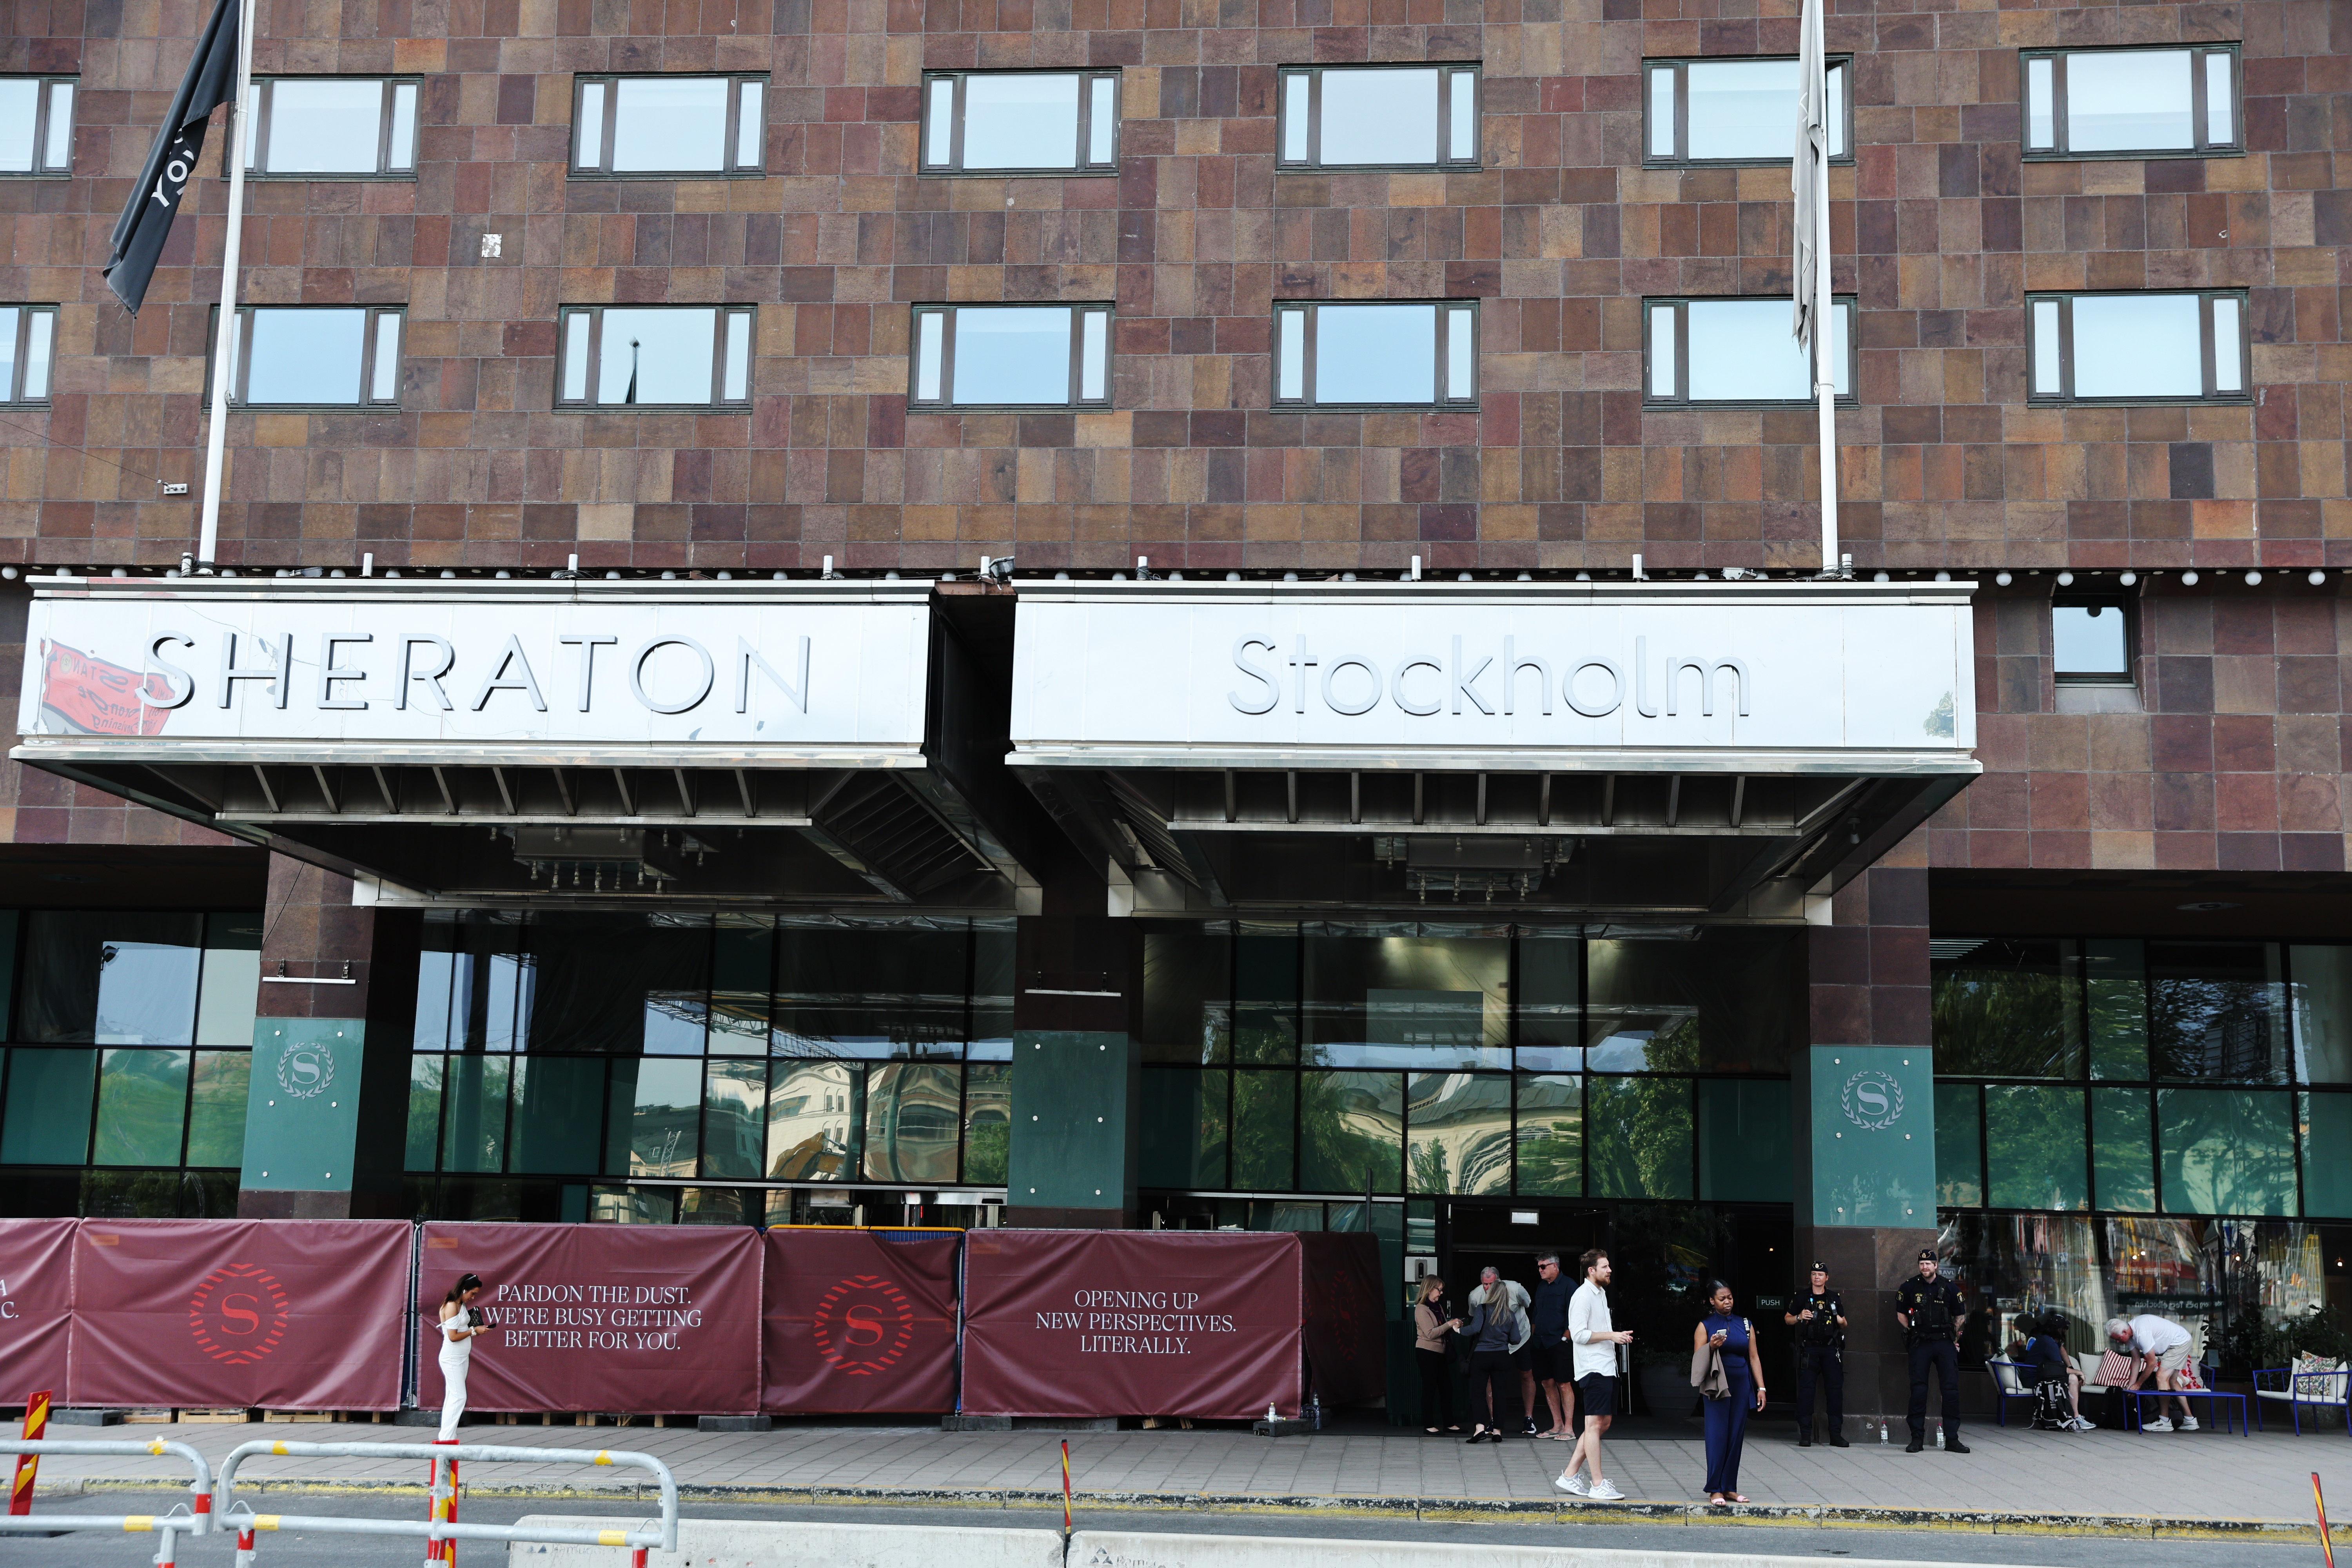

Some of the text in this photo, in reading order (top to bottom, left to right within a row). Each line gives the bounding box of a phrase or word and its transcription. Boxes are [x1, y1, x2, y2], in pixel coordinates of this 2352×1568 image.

[134, 630, 810, 715] SHERATON
[1227, 632, 1750, 718] Stockholm
[497, 1285, 692, 1304] PARDON THE DUST.
[1074, 1290, 1199, 1309] OPENING UP
[0, 1301, 19, 1319] C.
[555, 1308, 606, 1326] BUSY
[611, 1308, 702, 1327] GETTING
[1035, 1312, 1236, 1332] NEW PERSPECTIVES.
[505, 1330, 681, 1350] BETTER FOR YOU.
[1081, 1335, 1191, 1354] LITERALLY.
